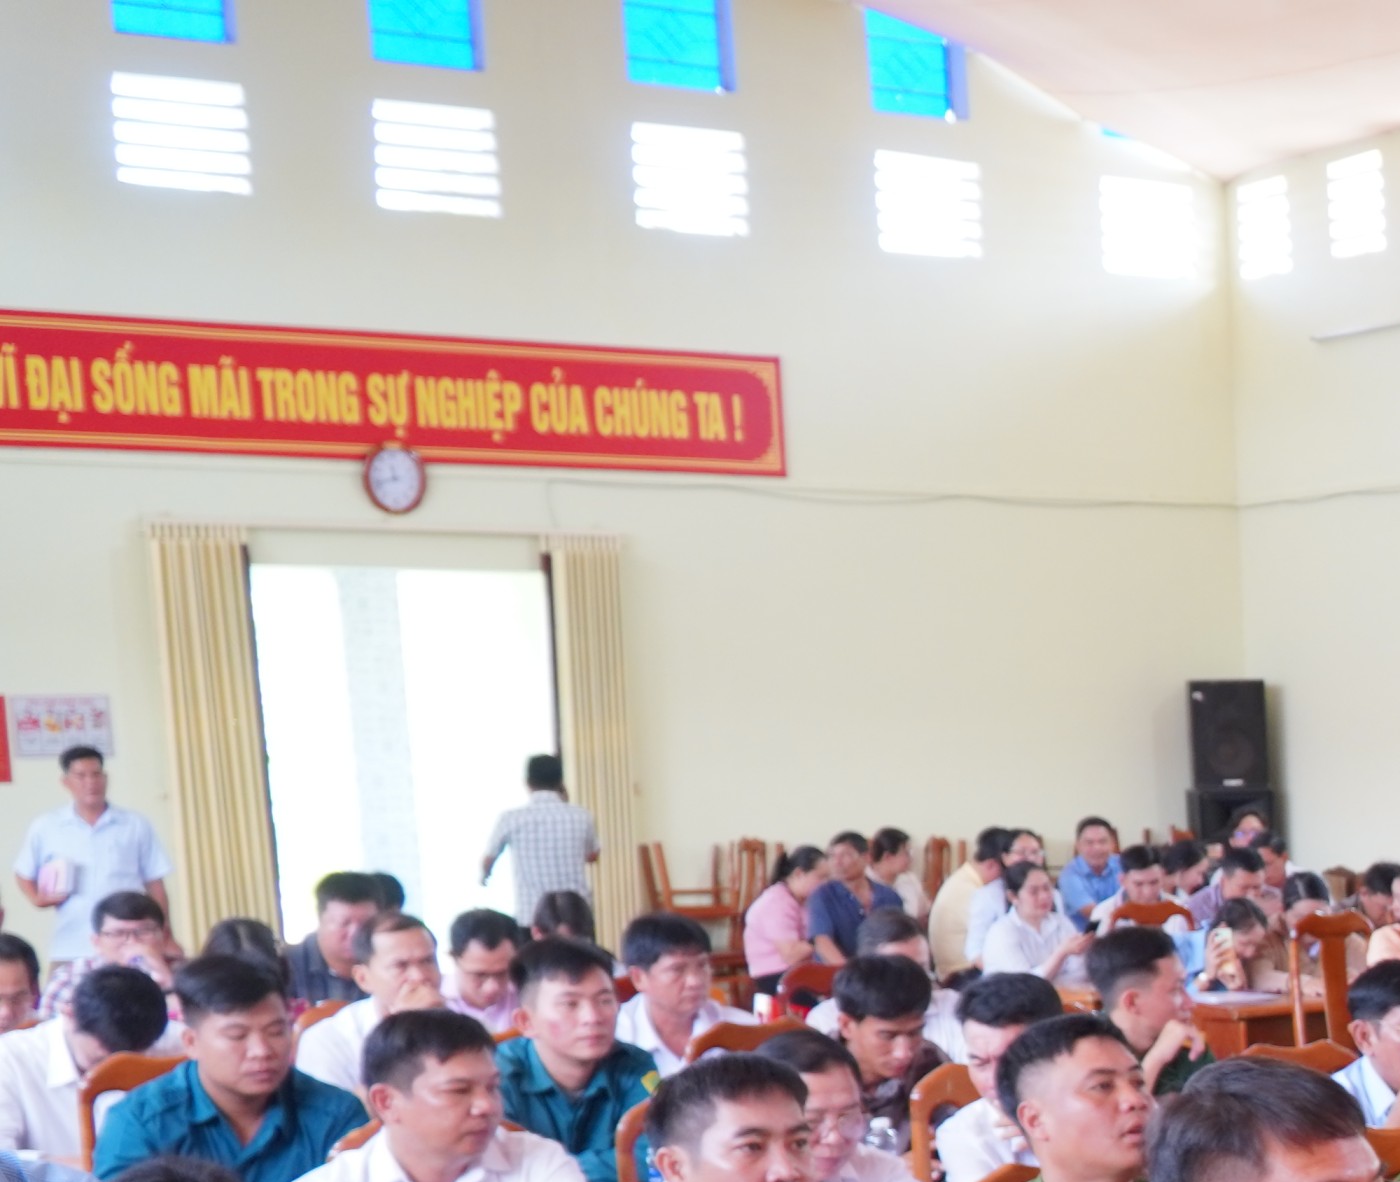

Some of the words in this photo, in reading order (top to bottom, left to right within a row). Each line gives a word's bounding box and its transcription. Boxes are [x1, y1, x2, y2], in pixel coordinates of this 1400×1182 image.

[0, 342, 20, 409] Ĩ
[25, 353, 84, 424] ĐẠI
[91, 341, 181, 416] SỐNG
[189, 356, 251, 420] MÃI
[258, 368, 359, 426] TRONG
[367, 373, 410, 437] SỰ
[415, 371, 523, 443] NGHIỆP
[530, 367, 589, 437] CỦA
[594, 379, 688, 440] CHÚNG
[694, 391, 726, 441] TA
[732, 395, 744, 442] !
